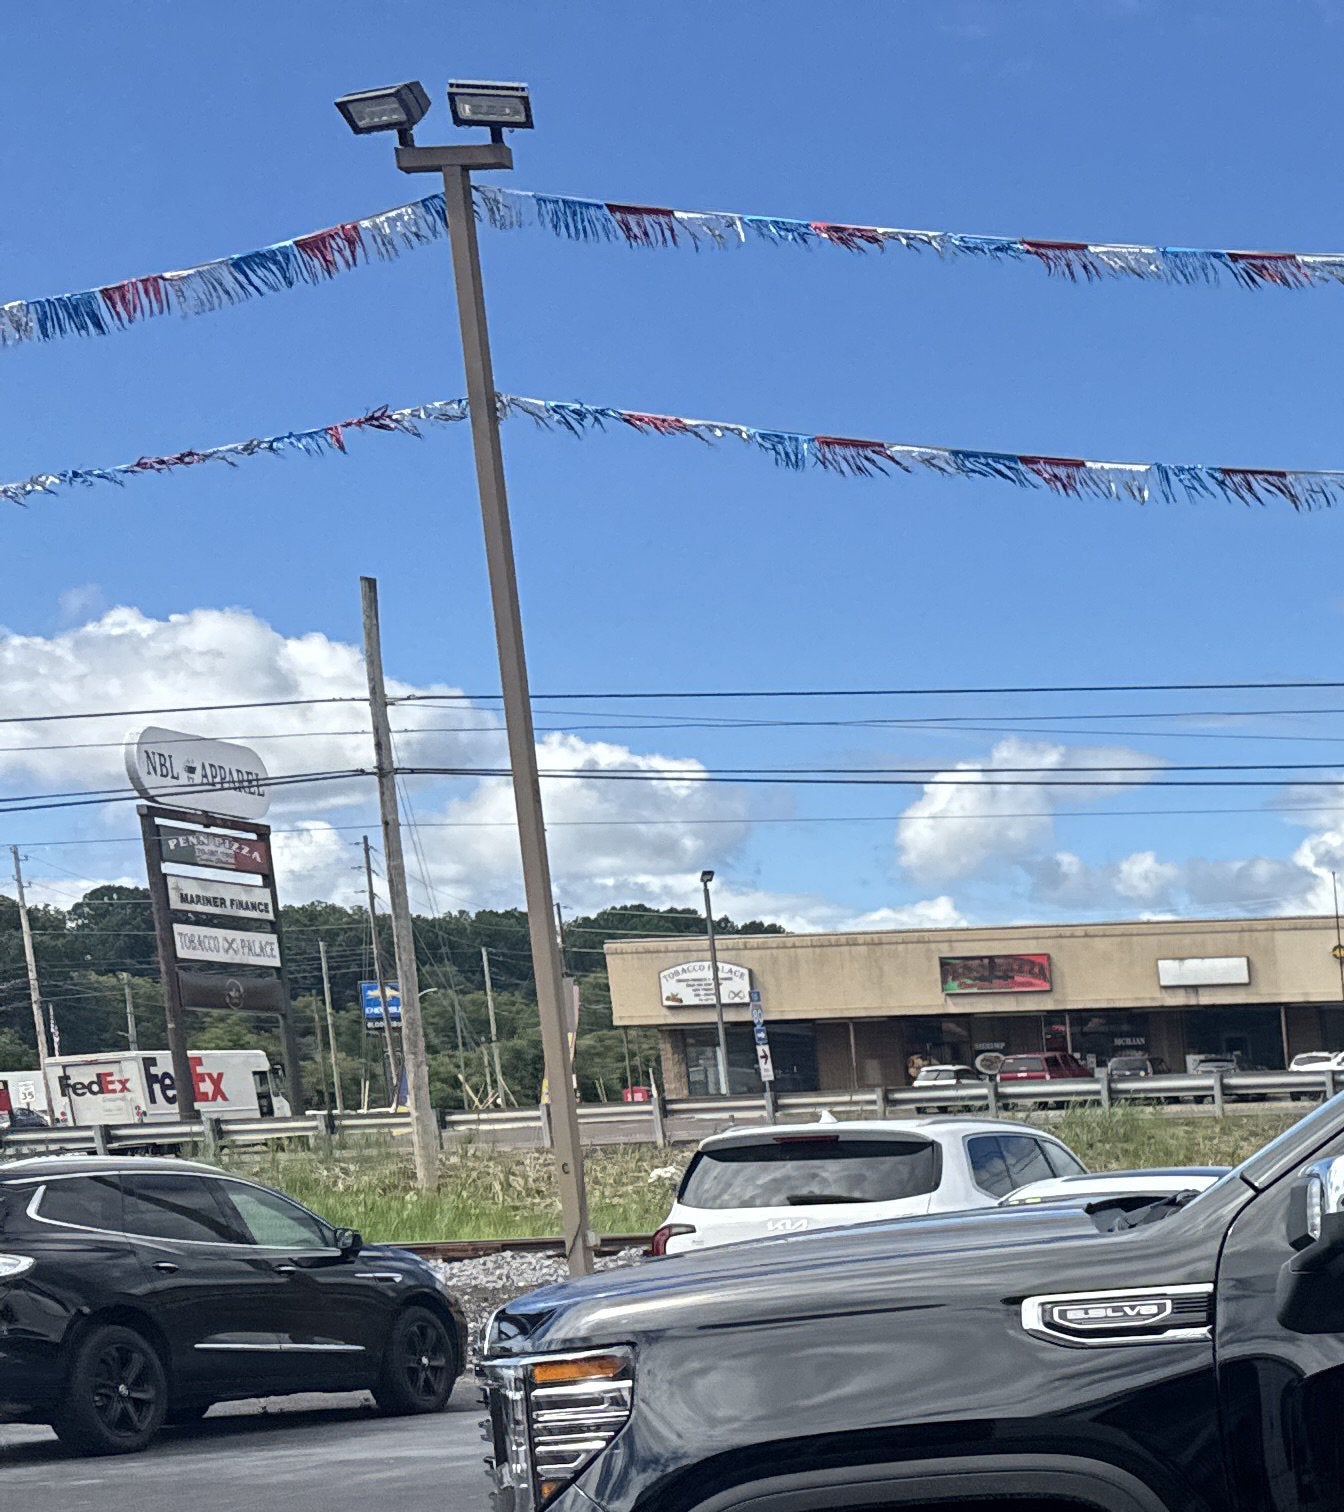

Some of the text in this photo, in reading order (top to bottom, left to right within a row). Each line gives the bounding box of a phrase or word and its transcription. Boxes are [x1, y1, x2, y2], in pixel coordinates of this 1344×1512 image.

[143, 750, 265, 798] NBL APPAREL
[167, 835, 209, 850] PENN
[215, 837, 264, 863] PIZZA
[179, 892, 271, 914] MARINER FINANCE
[177, 931, 278, 959] TOBACCO PALACE
[662, 964, 747, 983] TOBACCO LACE
[58, 1072, 132, 1098] FedEx
[143, 1056, 230, 1105] FeEx
